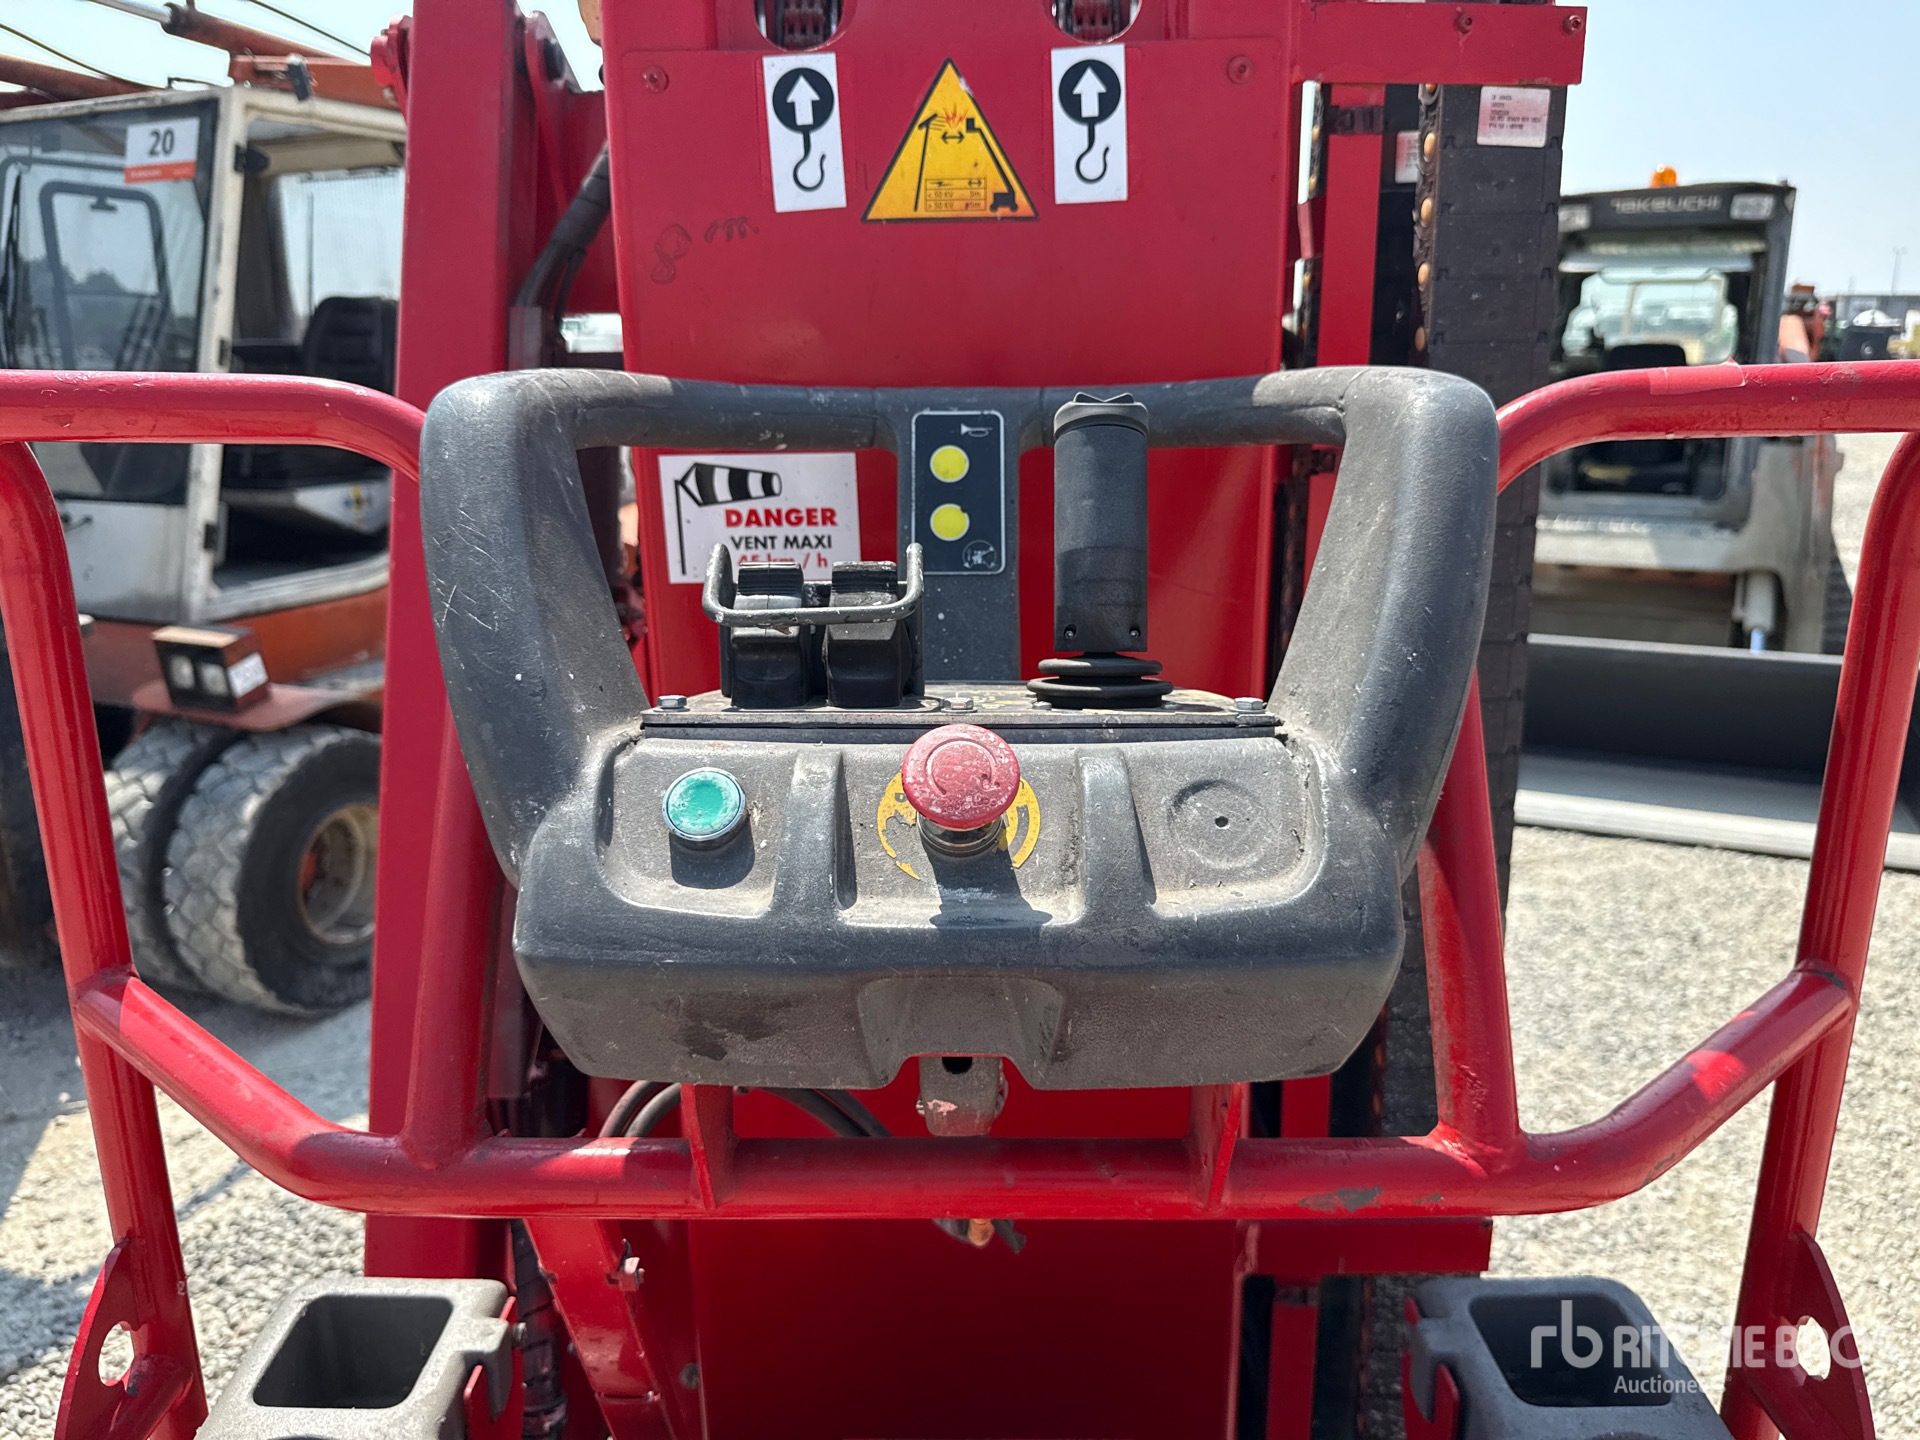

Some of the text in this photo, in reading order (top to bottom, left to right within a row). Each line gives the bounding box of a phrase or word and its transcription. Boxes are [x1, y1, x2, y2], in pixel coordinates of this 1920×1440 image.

[148, 127, 175, 157] 20
[1610, 194, 1721, 214] TAKEUCHI
[724, 507, 837, 528] DANGER
[730, 534, 832, 550] VENT MAXI
[817, 552, 828, 568] h
